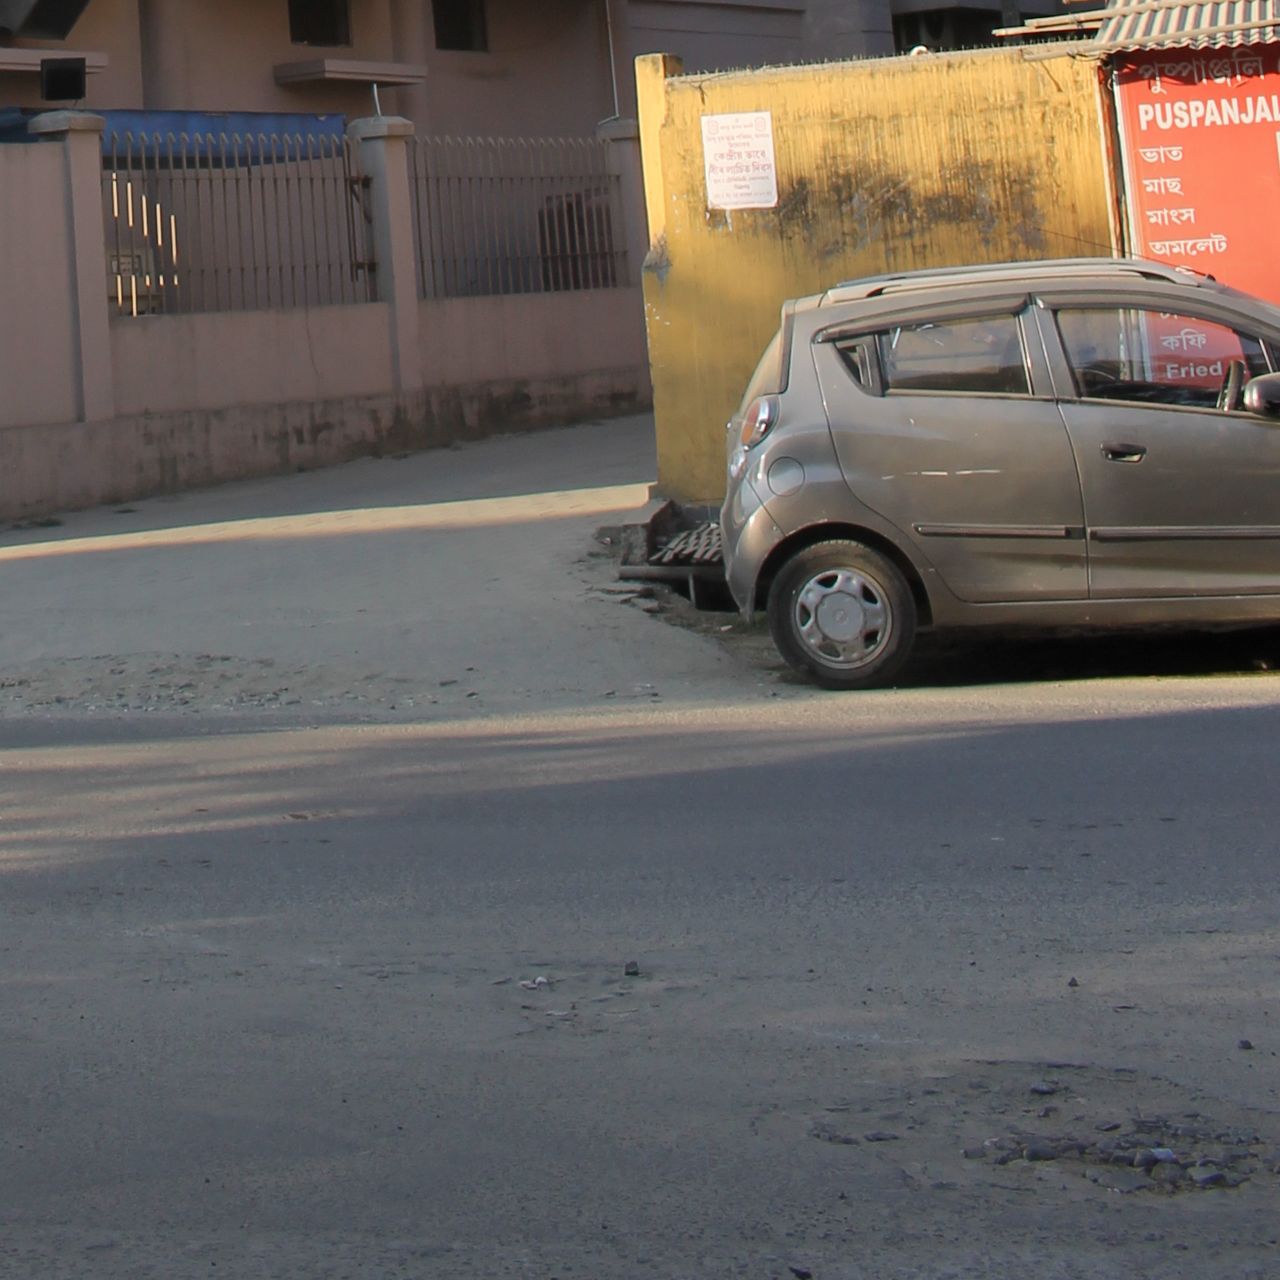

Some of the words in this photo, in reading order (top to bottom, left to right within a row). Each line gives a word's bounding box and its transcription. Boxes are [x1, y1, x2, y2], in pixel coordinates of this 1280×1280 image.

[1139, 145, 1183, 164] ভাত
[1142, 176, 1184, 196] মাছ
[1146, 207, 1196, 226] মাংস
[1149, 232, 1228, 257] অমলেট
[1160, 328, 1207, 351] কফি
[1166, 361, 1223, 379] Fried
